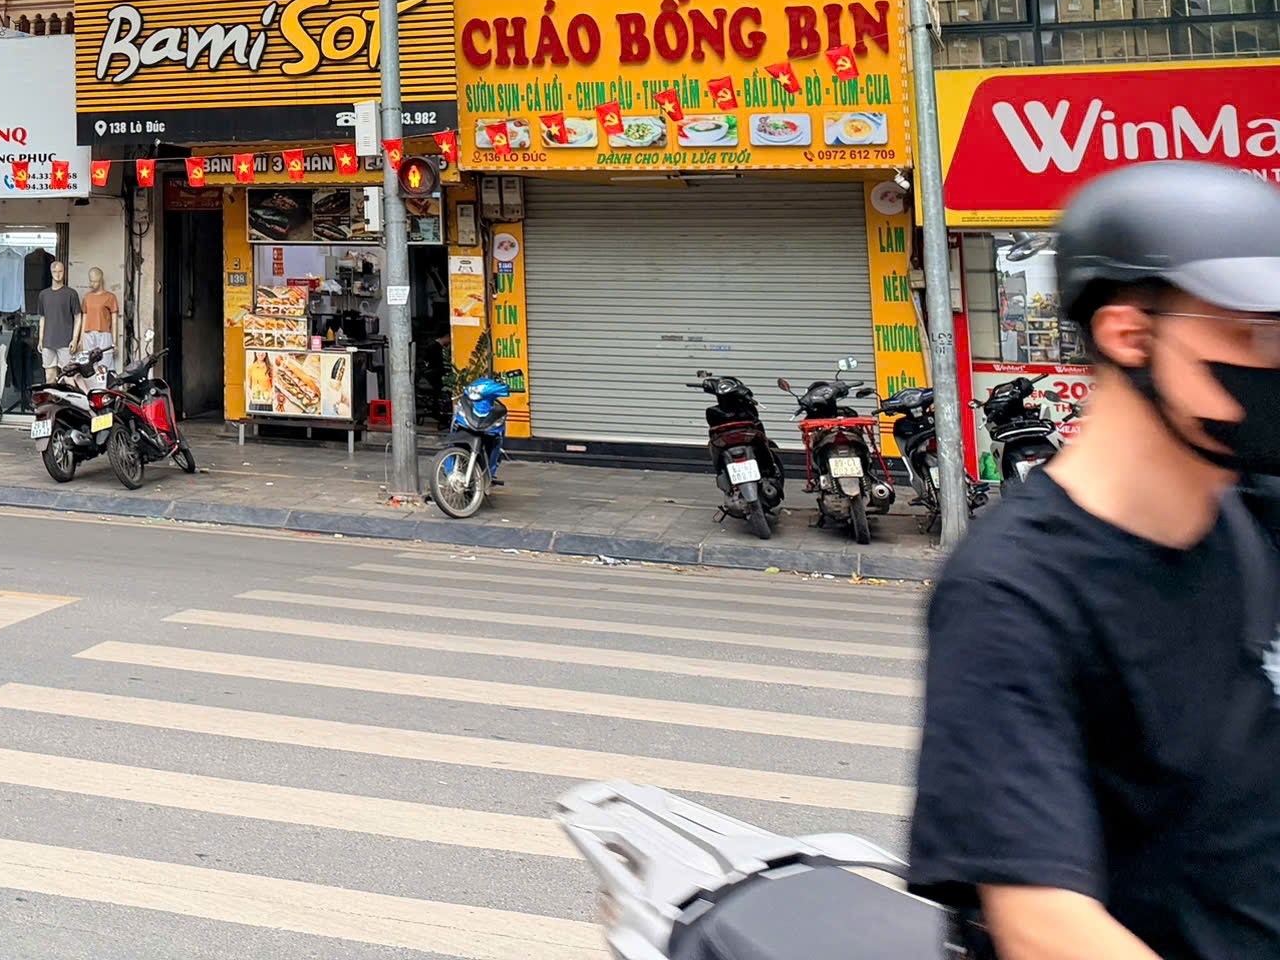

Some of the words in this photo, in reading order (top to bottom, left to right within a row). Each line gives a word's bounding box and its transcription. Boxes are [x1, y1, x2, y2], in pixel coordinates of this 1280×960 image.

[784, 0, 891, 59] BIN
[866, 74, 892, 105] CUA
[109, 122, 127, 134] 138
[130, 120, 143, 133] Lò
[146, 119, 166, 133] Đúc
[992, 98, 1280, 174] WinMa
[272, 156, 283, 172] 3
[483, 152, 501, 162] 136
[521, 150, 548, 162] ĐÚC
[597, 151, 628, 164] DÀNH
[629, 152, 659, 164] CHO
[817, 149, 847, 160] 0972
[849, 149, 870, 160] 612
[874, 149, 896, 160] 709
[878, 221, 905, 254] LÀM
[882, 271, 909, 303] NÊN
[495, 301, 518, 325] TÍN
